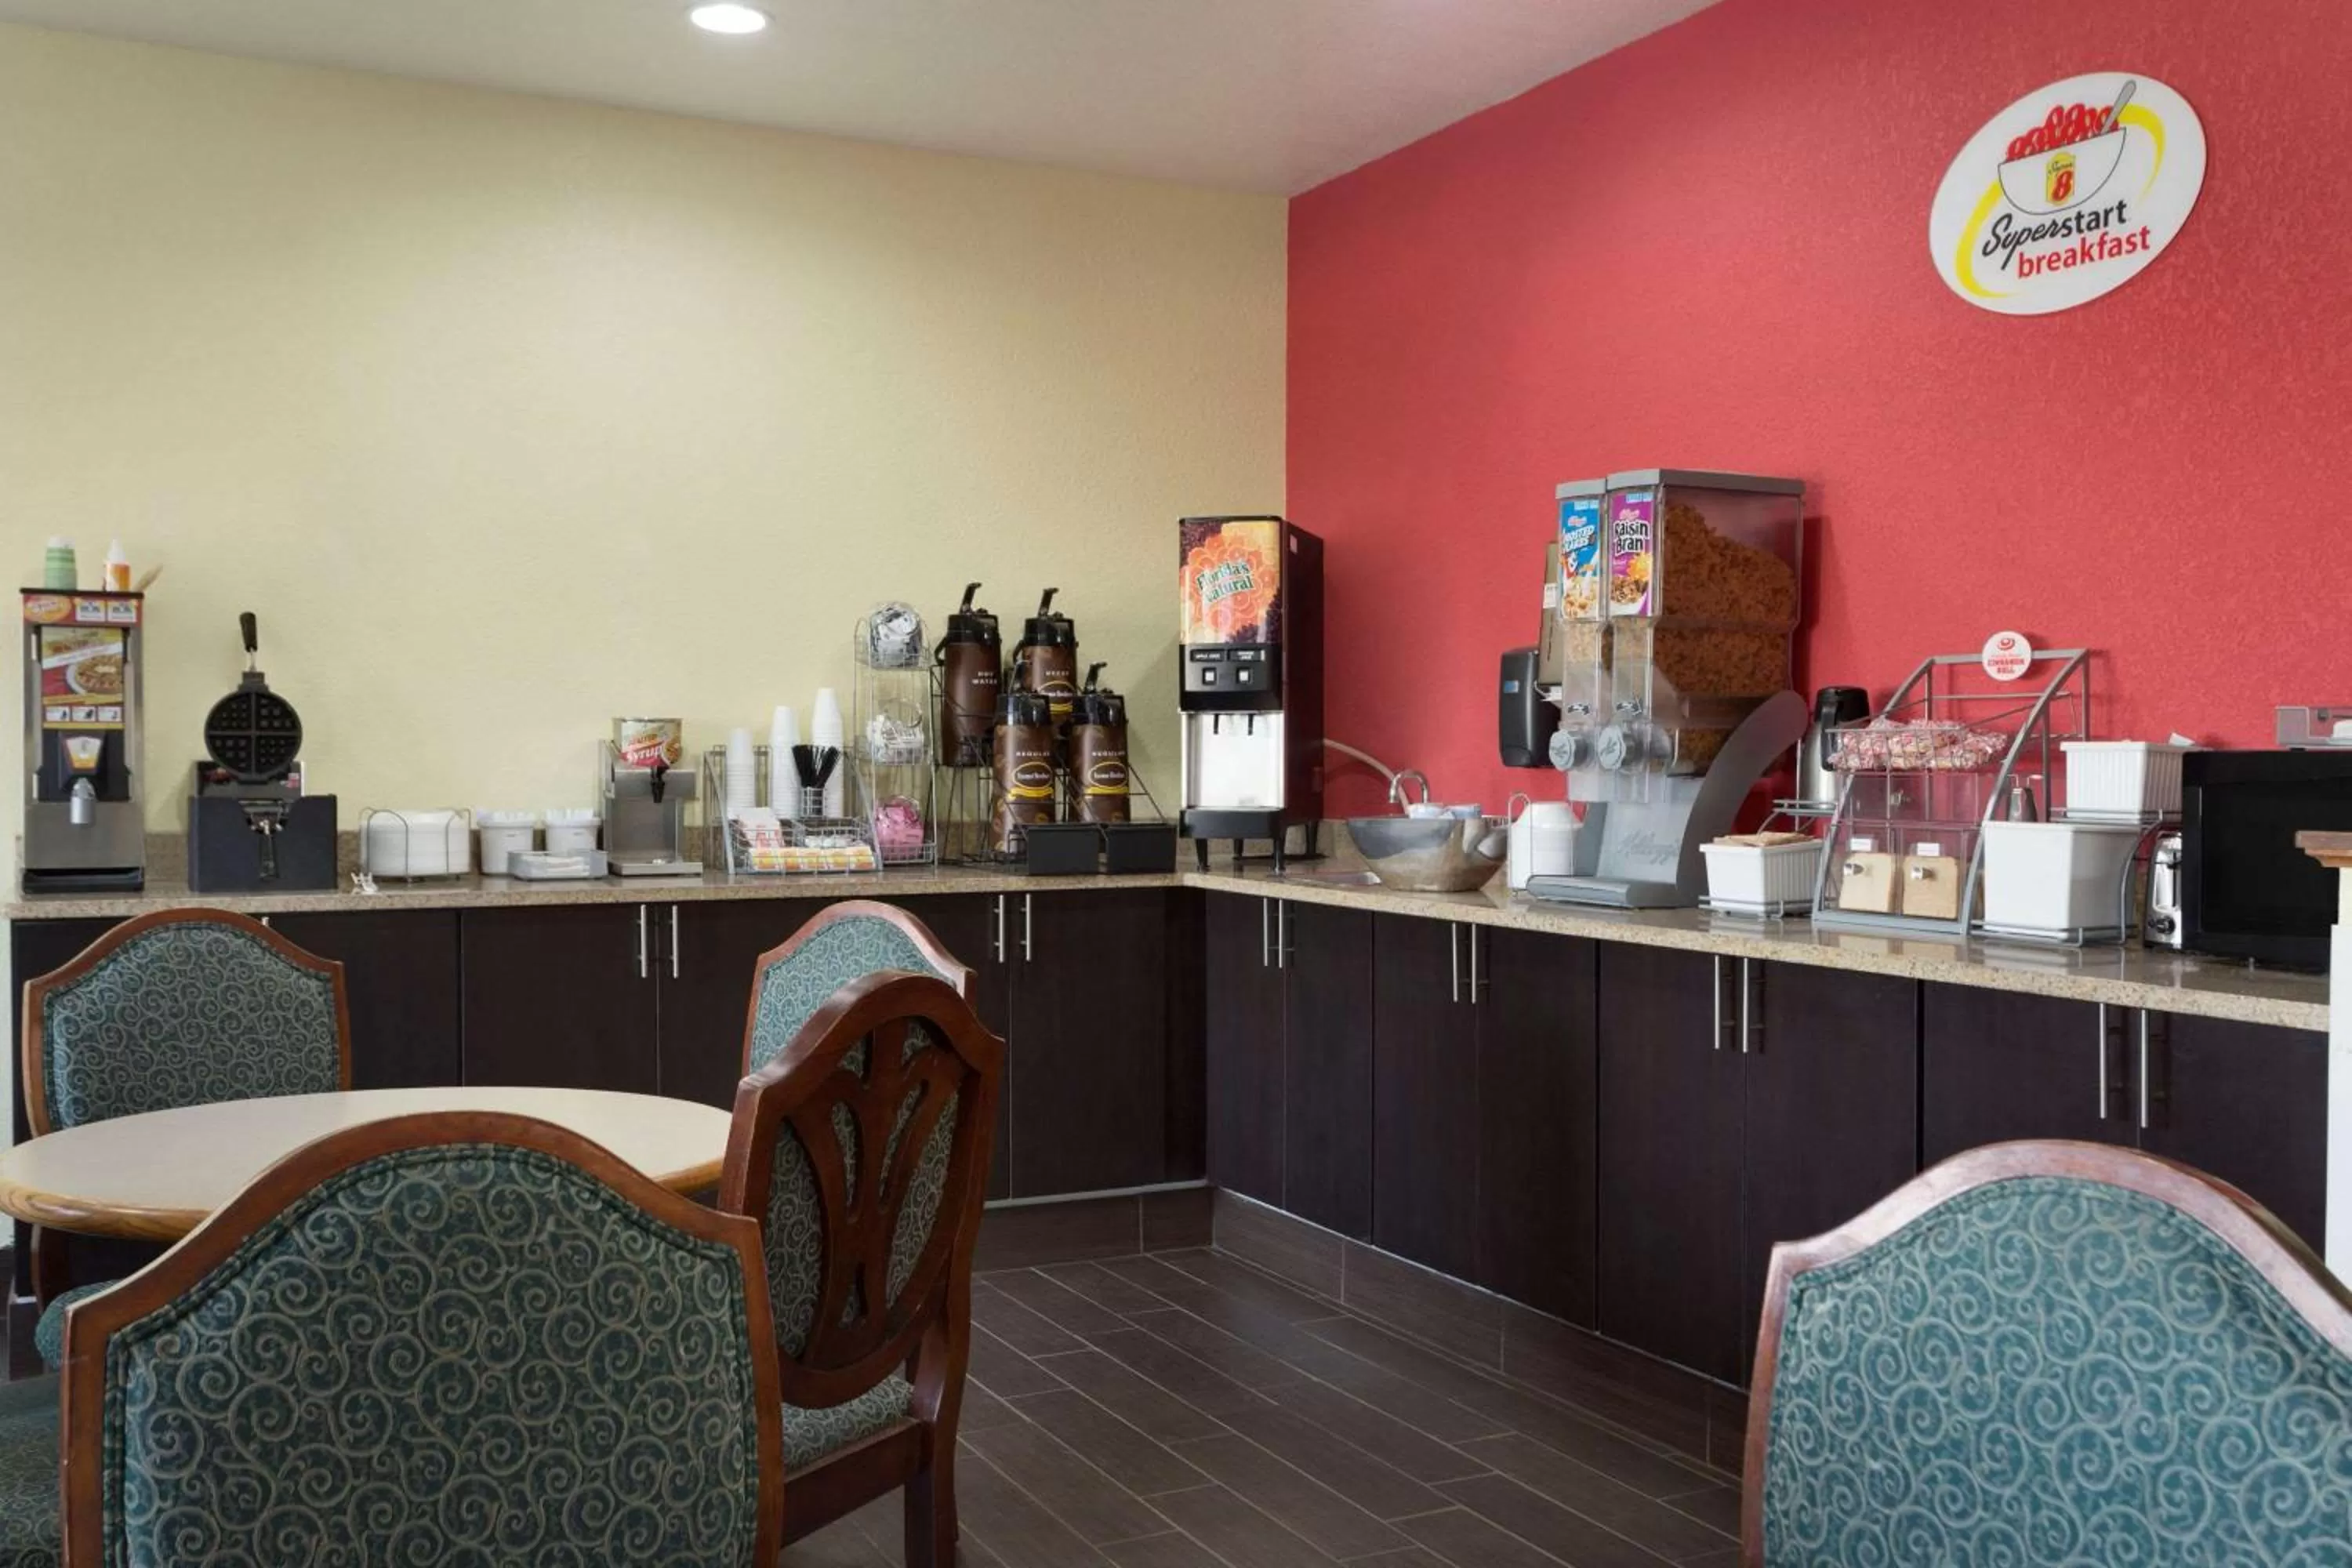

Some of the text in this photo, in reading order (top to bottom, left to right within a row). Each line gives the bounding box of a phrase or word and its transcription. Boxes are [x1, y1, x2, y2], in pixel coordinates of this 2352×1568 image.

[2051, 170, 2074, 201] 8
[1982, 199, 2127, 270] Superstart
[2017, 225, 2151, 279] breakfast
